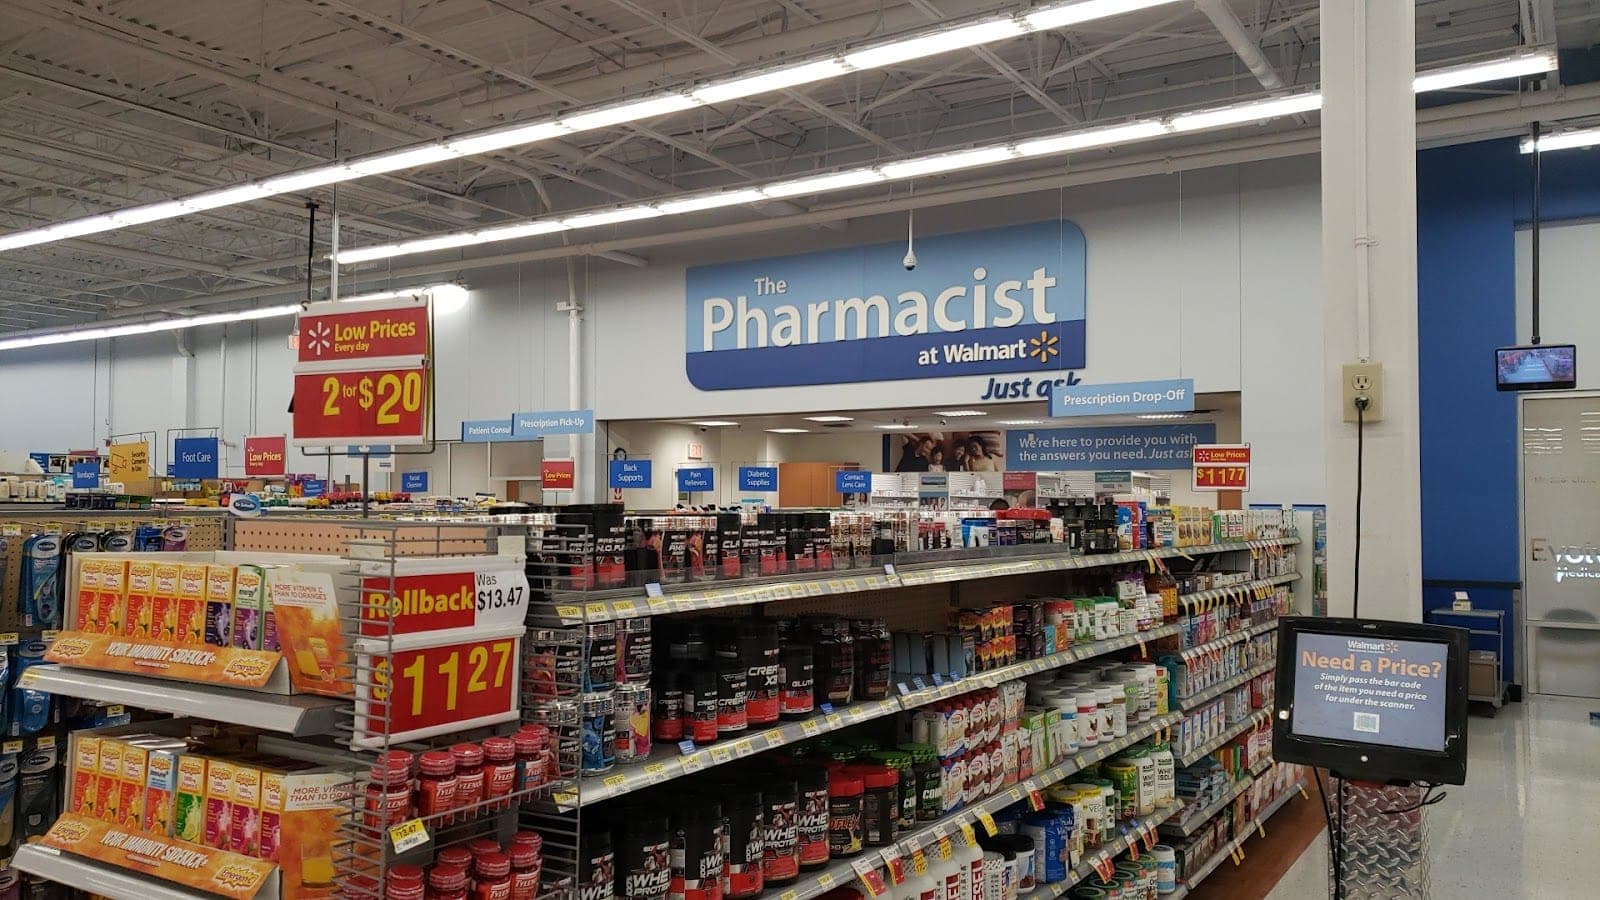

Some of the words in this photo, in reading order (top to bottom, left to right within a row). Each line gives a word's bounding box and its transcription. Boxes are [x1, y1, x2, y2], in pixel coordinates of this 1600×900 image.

[754, 276, 787, 296] The
[703, 265, 1058, 352] Pharmacist
[334, 323, 364, 342] Low
[370, 319, 416, 339] Prices
[334, 343, 355, 354] Every
[355, 341, 370, 352] day
[918, 348, 938, 365] at
[944, 339, 1027, 364] Walmart
[981, 376, 1031, 400] Just
[322, 376, 340, 416] 2
[343, 384, 357, 398] for
[359, 371, 422, 425] $20
[1063, 391, 1130, 406] Prescription
[1133, 389, 1186, 404] Drop-Off
[520, 418, 558, 428] Prescription
[559, 418, 585, 427] Pick-Up
[468, 426, 489, 436] Patient
[1019, 436, 1050, 448] We're
[1052, 435, 1077, 448] here
[1079, 437, 1093, 447] to
[1095, 434, 1140, 450] provide
[1143, 437, 1167, 450] you
[1169, 433, 1198, 446] with
[182, 452, 197, 463] Foot
[197, 452, 211, 463] Care
[249, 453, 262, 462] Low
[263, 451, 281, 461] Prices
[1018, 450, 1038, 462] the
[1039, 450, 1086, 462] answers
[1088, 451, 1111, 464] you
[1113, 448, 1147, 461] need.
[1149, 448, 1173, 460] Just
[1210, 451, 1225, 459] Low
[1226, 450, 1246, 459] Prices
[624, 464, 637, 472] Back
[748, 470, 770, 478] Diabetic
[617, 473, 643, 483] Supports
[747, 478, 770, 487] Supplies
[476, 573, 498, 587] Was
[274, 590, 291, 598] THAN
[297, 591, 327, 600] ORANGES
[275, 583, 292, 592] MORE
[293, 584, 315, 593] VITAMIN
[368, 585, 474, 619] Rollback
[477, 586, 524, 612] $13.47
[1348, 640, 1385, 652] Walmart
[1302, 650, 1355, 671] Need
[1360, 661, 1371, 673] a
[1378, 658, 1442, 679] Price?
[1320, 672, 1348, 684] Simply
[1349, 675, 1368, 684] pass
[1369, 677, 1383, 686] the
[1384, 678, 1399, 687] bar
[1400, 680, 1422, 690] code
[1314, 682, 1324, 691] of
[1324, 683, 1337, 691] the
[1338, 684, 1358, 694] item
[1358, 687, 1374, 697] you
[1375, 688, 1397, 698] need
[1404, 691, 1428, 702] price
[1325, 693, 1338, 703] for
[1339, 695, 1364, 705] under
[1365, 697, 1379, 706] the
[1379, 701, 1416, 711] scanner.
[293, 785, 320, 795] MORE
[290, 793, 316, 802] THAN
[318, 793, 328, 801] 10
